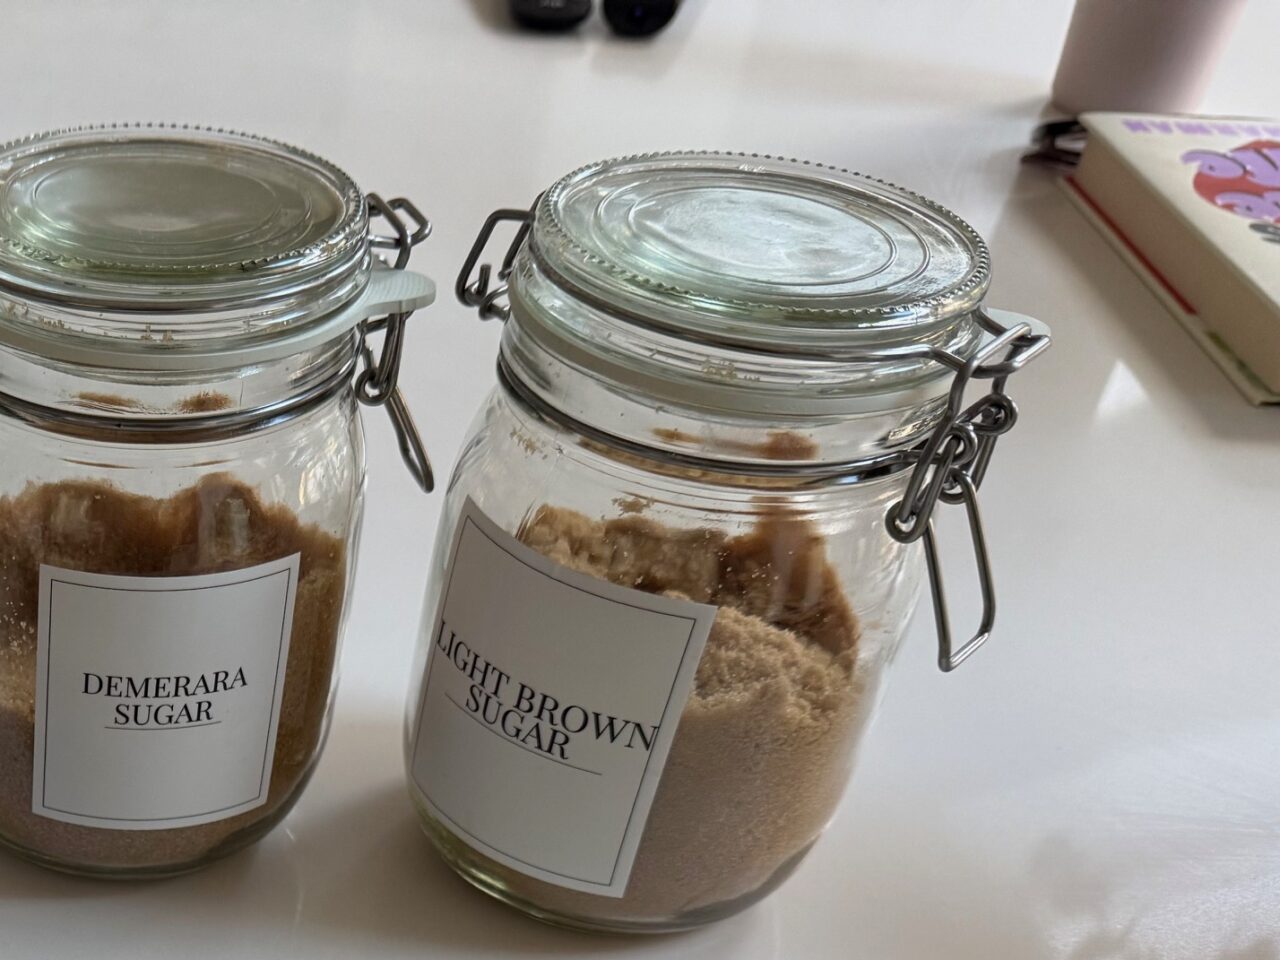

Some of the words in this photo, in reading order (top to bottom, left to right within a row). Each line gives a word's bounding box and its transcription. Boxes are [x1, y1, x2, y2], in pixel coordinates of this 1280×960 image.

[82, 666, 248, 698] DEMERARA
[436, 619, 510, 698] LIGHT
[513, 682, 661, 752] BROWN
[114, 700, 213, 726] SUGAR
[465, 683, 570, 760] SUGAR
